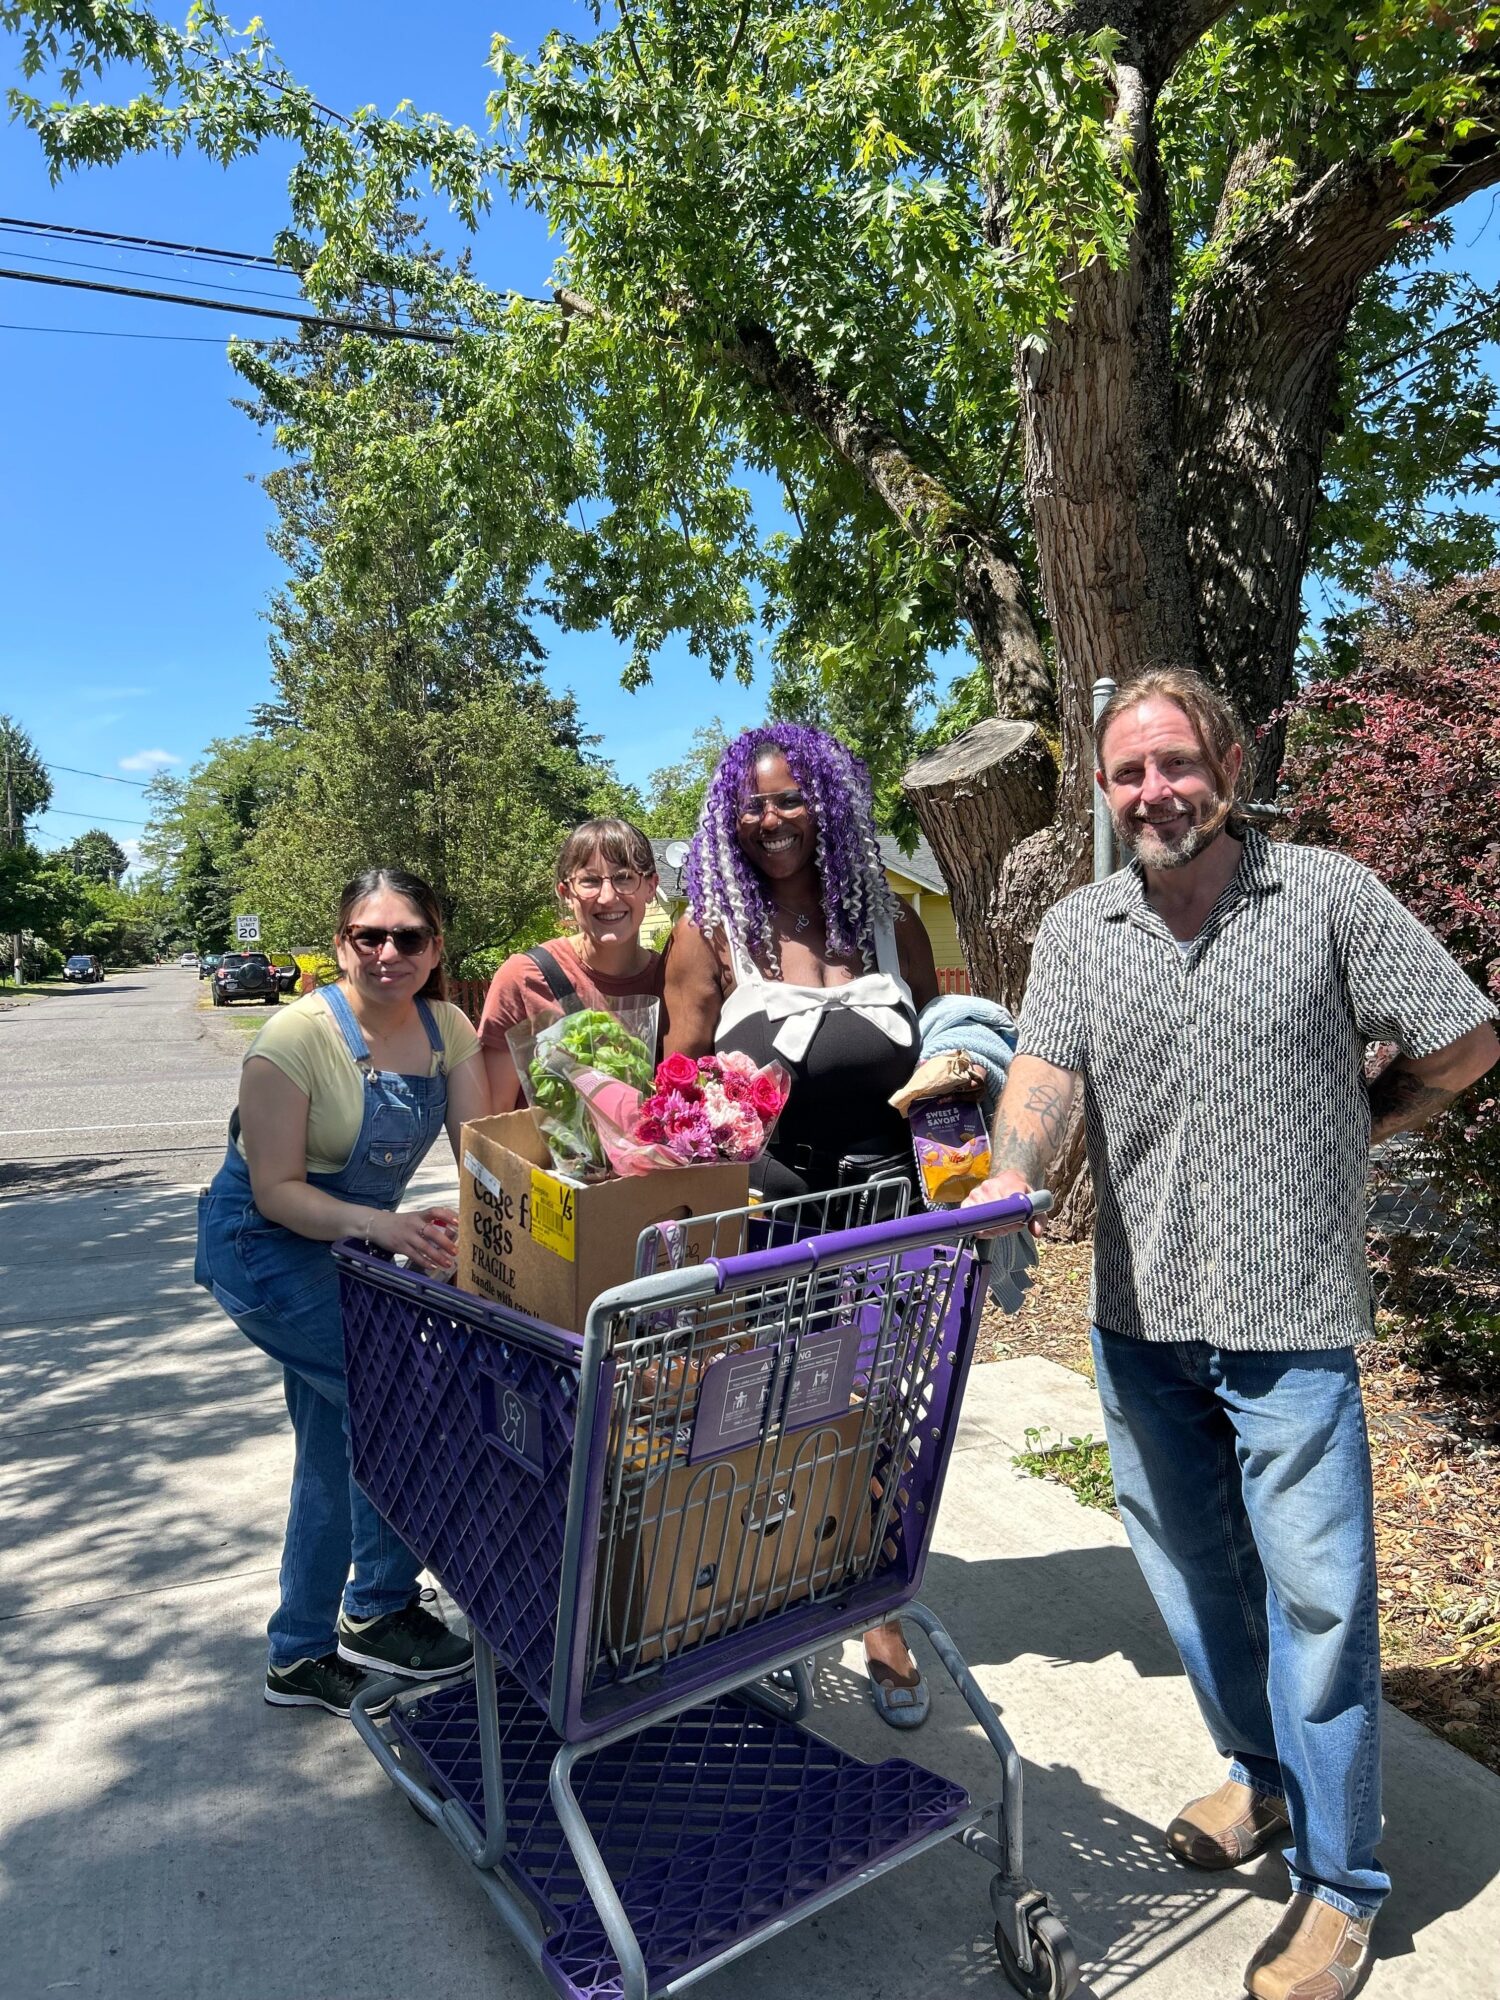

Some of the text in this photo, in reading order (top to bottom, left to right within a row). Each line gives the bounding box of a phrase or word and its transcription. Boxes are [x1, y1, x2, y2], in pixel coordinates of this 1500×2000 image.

[239, 928, 257, 938] 20
[925, 1109, 952, 1120] SWEET
[927, 1114, 960, 1127] SAVORY
[560, 1186, 573, 1220] 1/3
[474, 1211, 512, 1256] eggs
[472, 1243, 516, 1289] FRAGILE
[471, 1269, 496, 1296] handle
[496, 1289, 513, 1308] with
